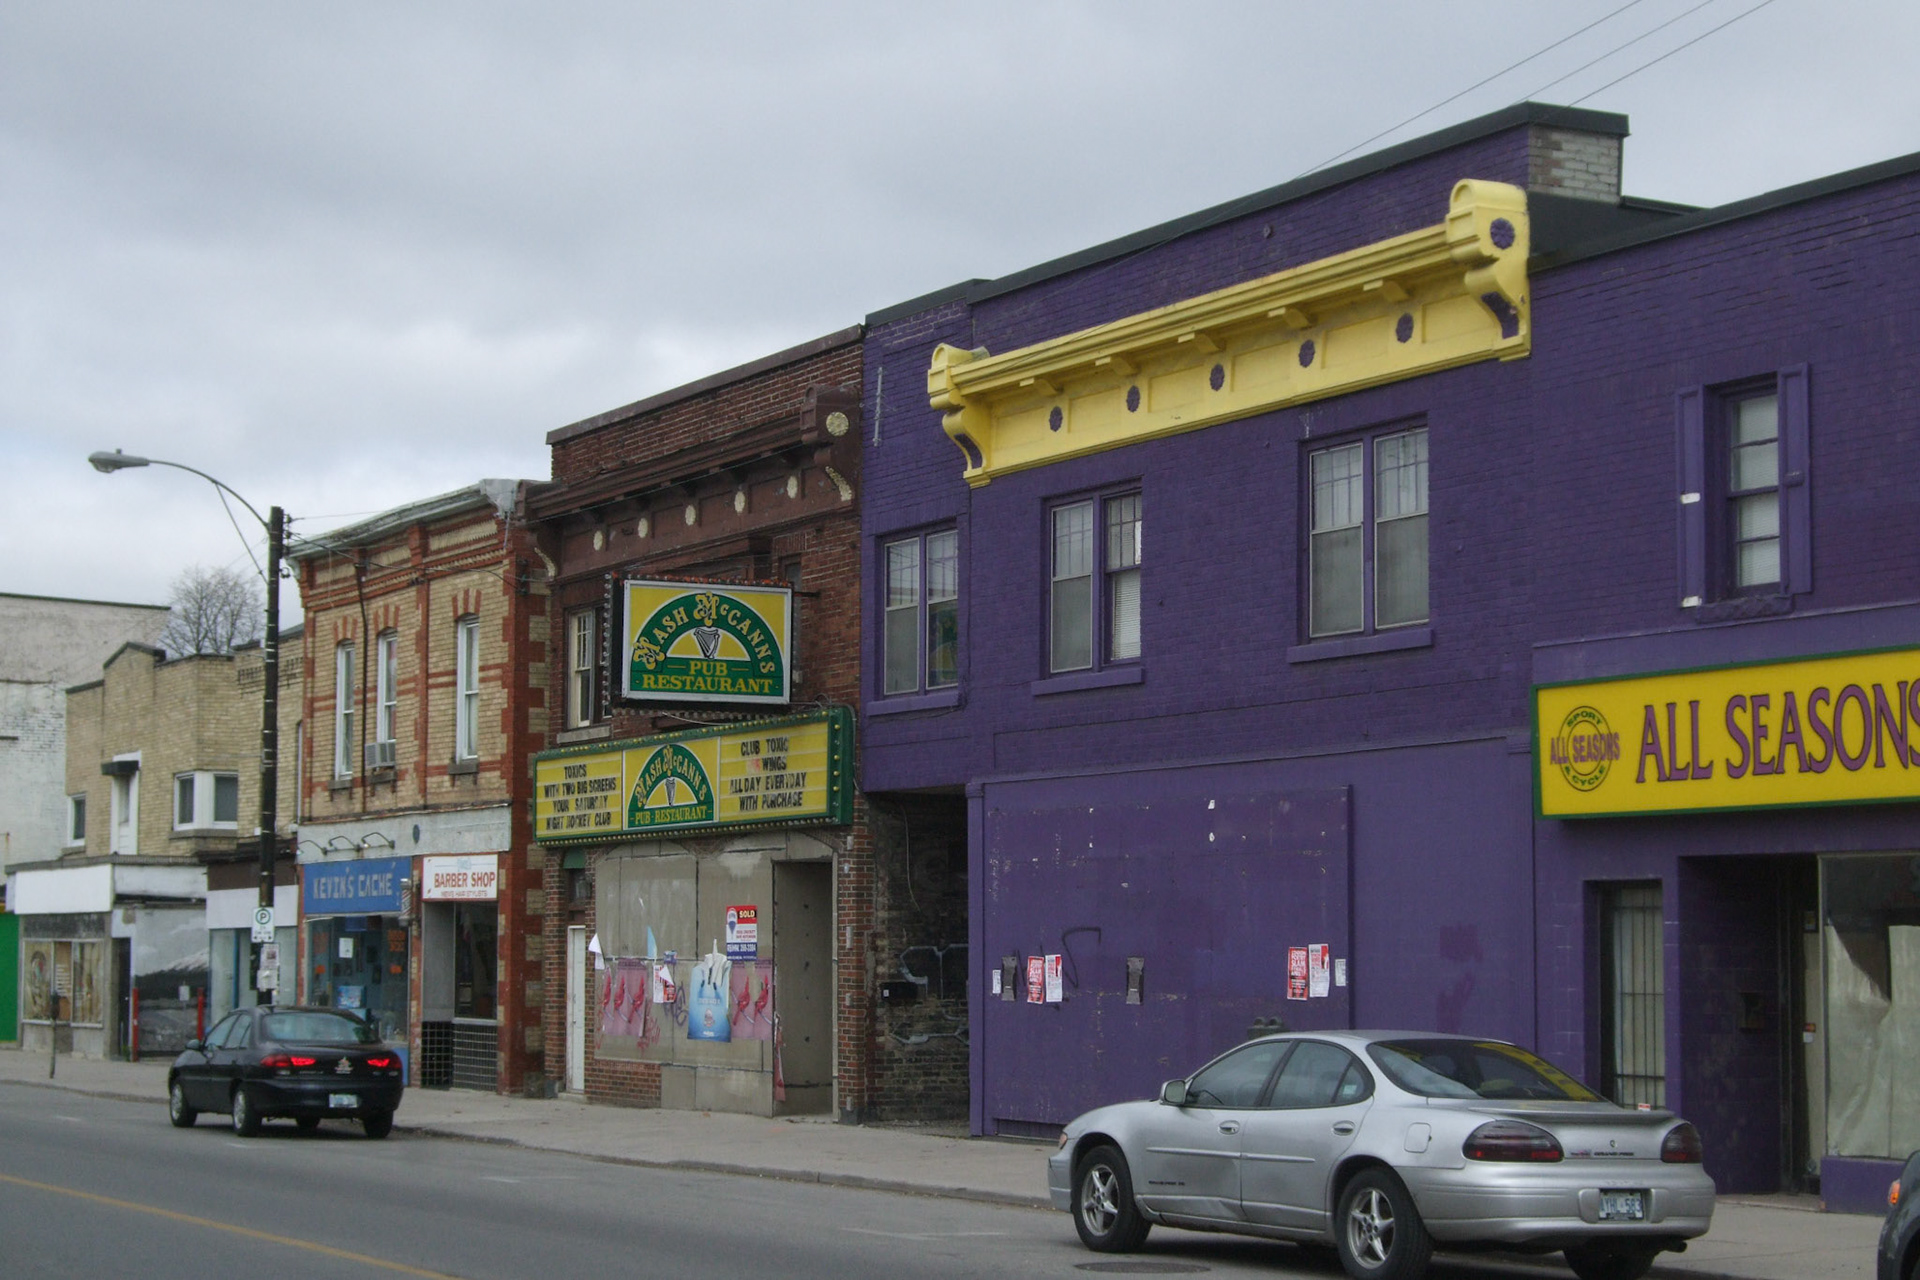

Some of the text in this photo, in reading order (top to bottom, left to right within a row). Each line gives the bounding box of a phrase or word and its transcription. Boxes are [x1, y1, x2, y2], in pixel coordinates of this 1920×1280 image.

[633, 607, 689, 670] MASH
[689, 660, 728, 676] PUB
[642, 674, 773, 693] RESTAURANT
[1567, 710, 1602, 727] SPORT
[741, 736, 788, 756] CLUB TOXIC
[1550, 732, 1620, 765] ALL SEASONS
[1636, 700, 1714, 783] ALL
[564, 764, 587, 780] TOXICS
[762, 756, 787, 772] WINGS
[635, 757, 662, 807] MASH
[730, 772, 807, 793] ALL DAY EVERYDAY
[1572, 765, 1605, 786] CYCLE
[562, 782, 575, 796] TWO
[577, 781, 587, 794] BIG
[589, 777, 616, 793] SCREENS
[739, 791, 803, 811] WITH PURCHASE
[595, 812, 611, 826] CLUB
[635, 806, 707, 825] PUB RESTAURANT
[434, 871, 496, 888] BARBER SHOP
[739, 910, 755, 918] SOLD
